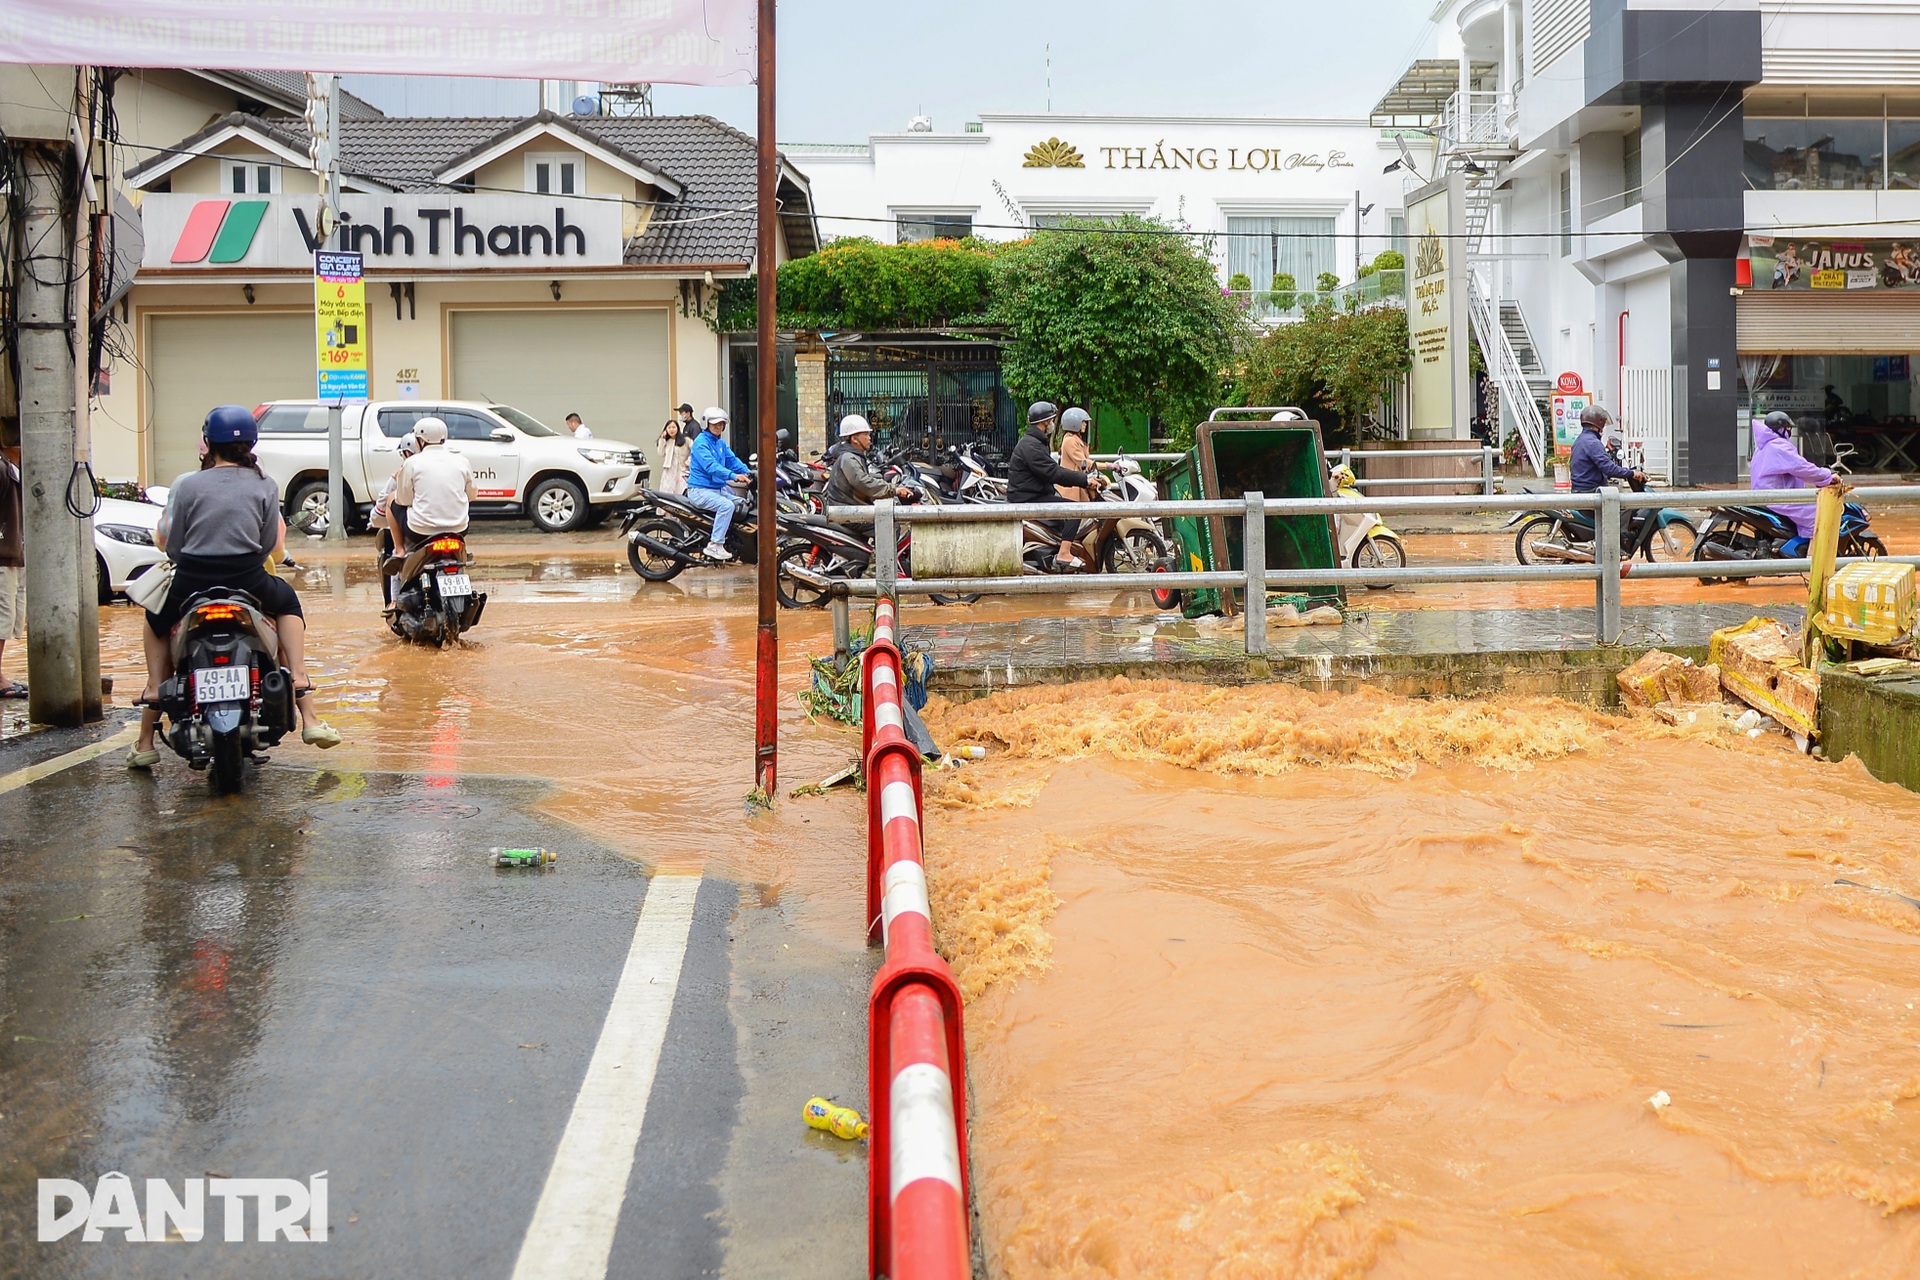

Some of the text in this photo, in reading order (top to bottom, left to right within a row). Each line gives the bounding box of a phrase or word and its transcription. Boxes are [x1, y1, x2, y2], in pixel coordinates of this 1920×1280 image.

[1099, 138, 1354, 174] THẮNG LỢI Wedding Center
[291, 206, 586, 256] Vinh Thanh
[1805, 250, 1874, 270] JANUS
[337, 285, 345, 299] 6
[320, 300, 335, 308] Máy
[328, 349, 349, 364] 169
[396, 368, 418, 379] 457
[1560, 376, 1577, 386] KOVA
[1566, 410, 1581, 420] CLE
[473, 467, 497, 480] anh
[203, 668, 241, 686] 49-AA
[199, 683, 247, 701] 591.14
